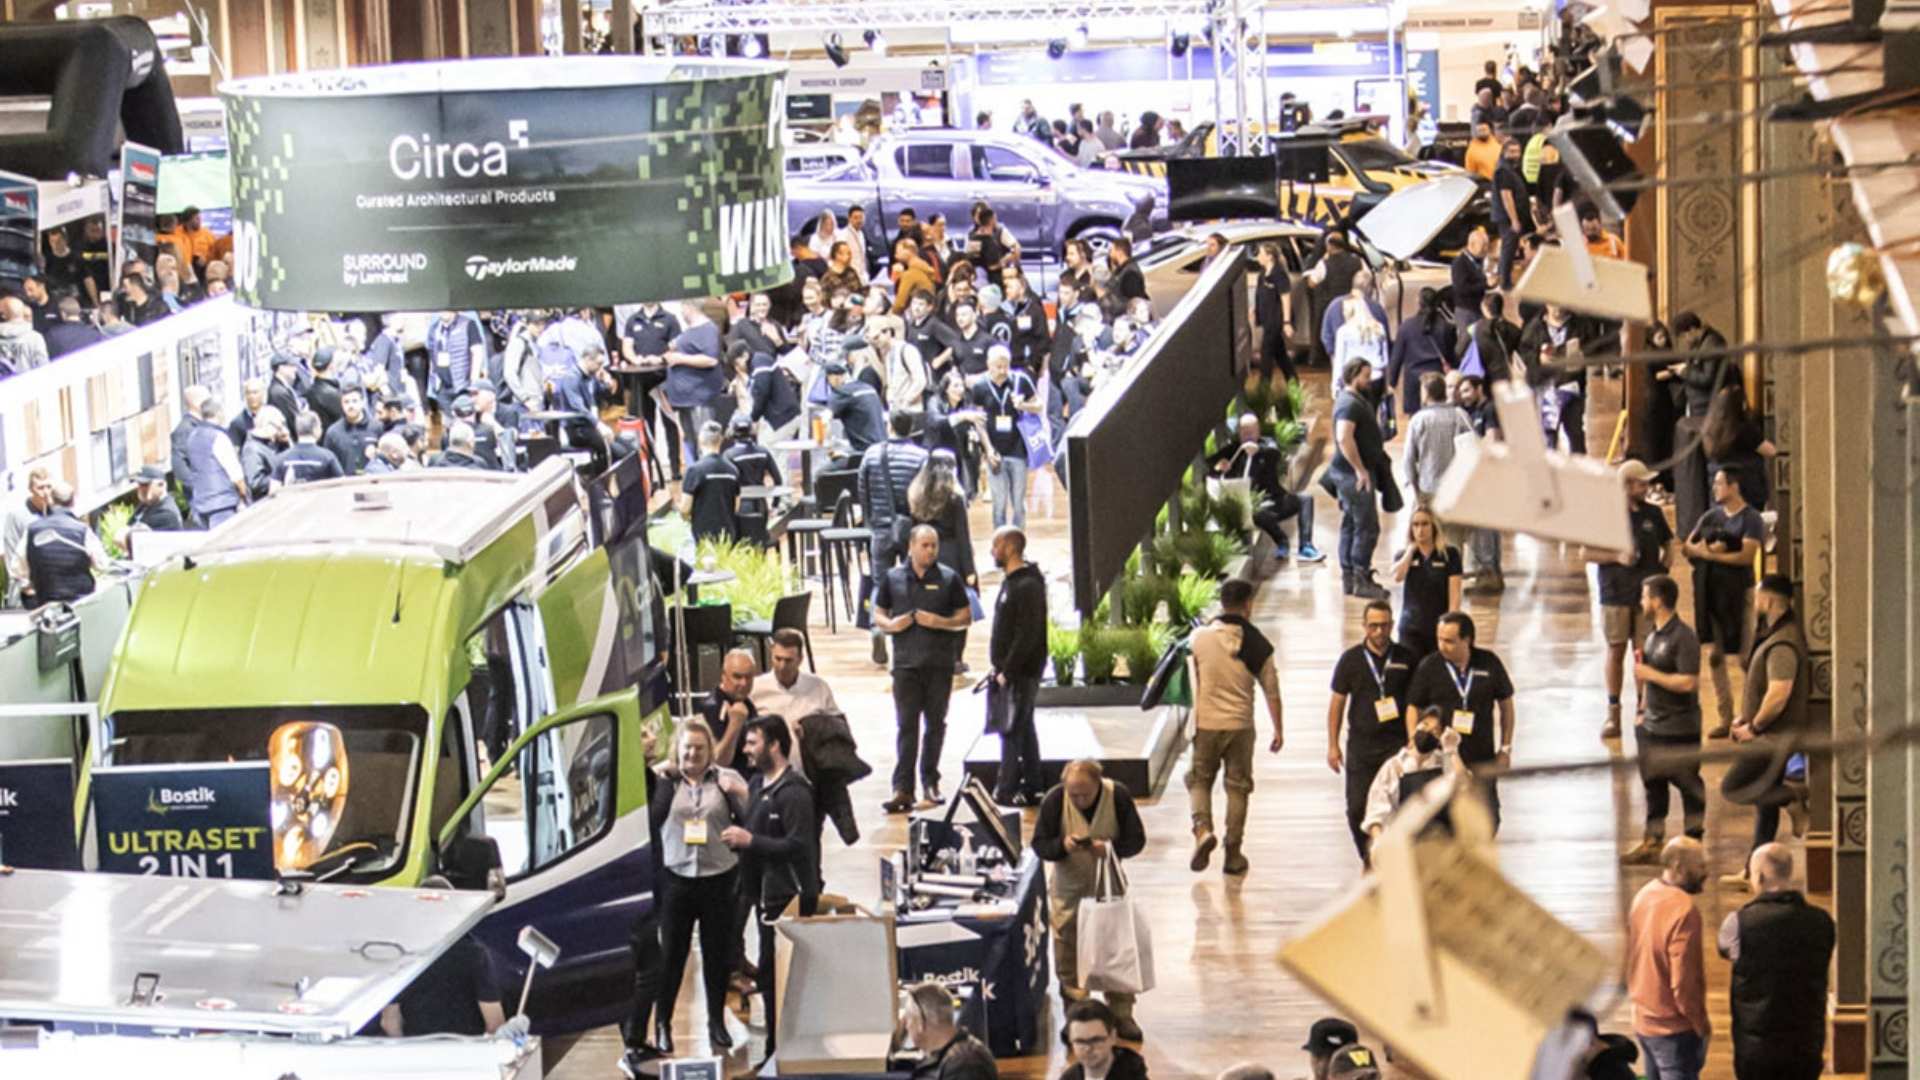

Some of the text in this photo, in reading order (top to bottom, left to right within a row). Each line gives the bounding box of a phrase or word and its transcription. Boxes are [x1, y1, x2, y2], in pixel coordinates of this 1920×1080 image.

[389, 133, 508, 180] Circa
[356, 189, 556, 209] Curated Architectural Products
[343, 253, 427, 271] SURROUND
[465, 255, 576, 281] TaylorMade
[343, 271, 358, 287] by
[160, 786, 215, 804] Bostik
[108, 827, 259, 855] ULTRASET
[138, 853, 234, 879] 2 IN 1
